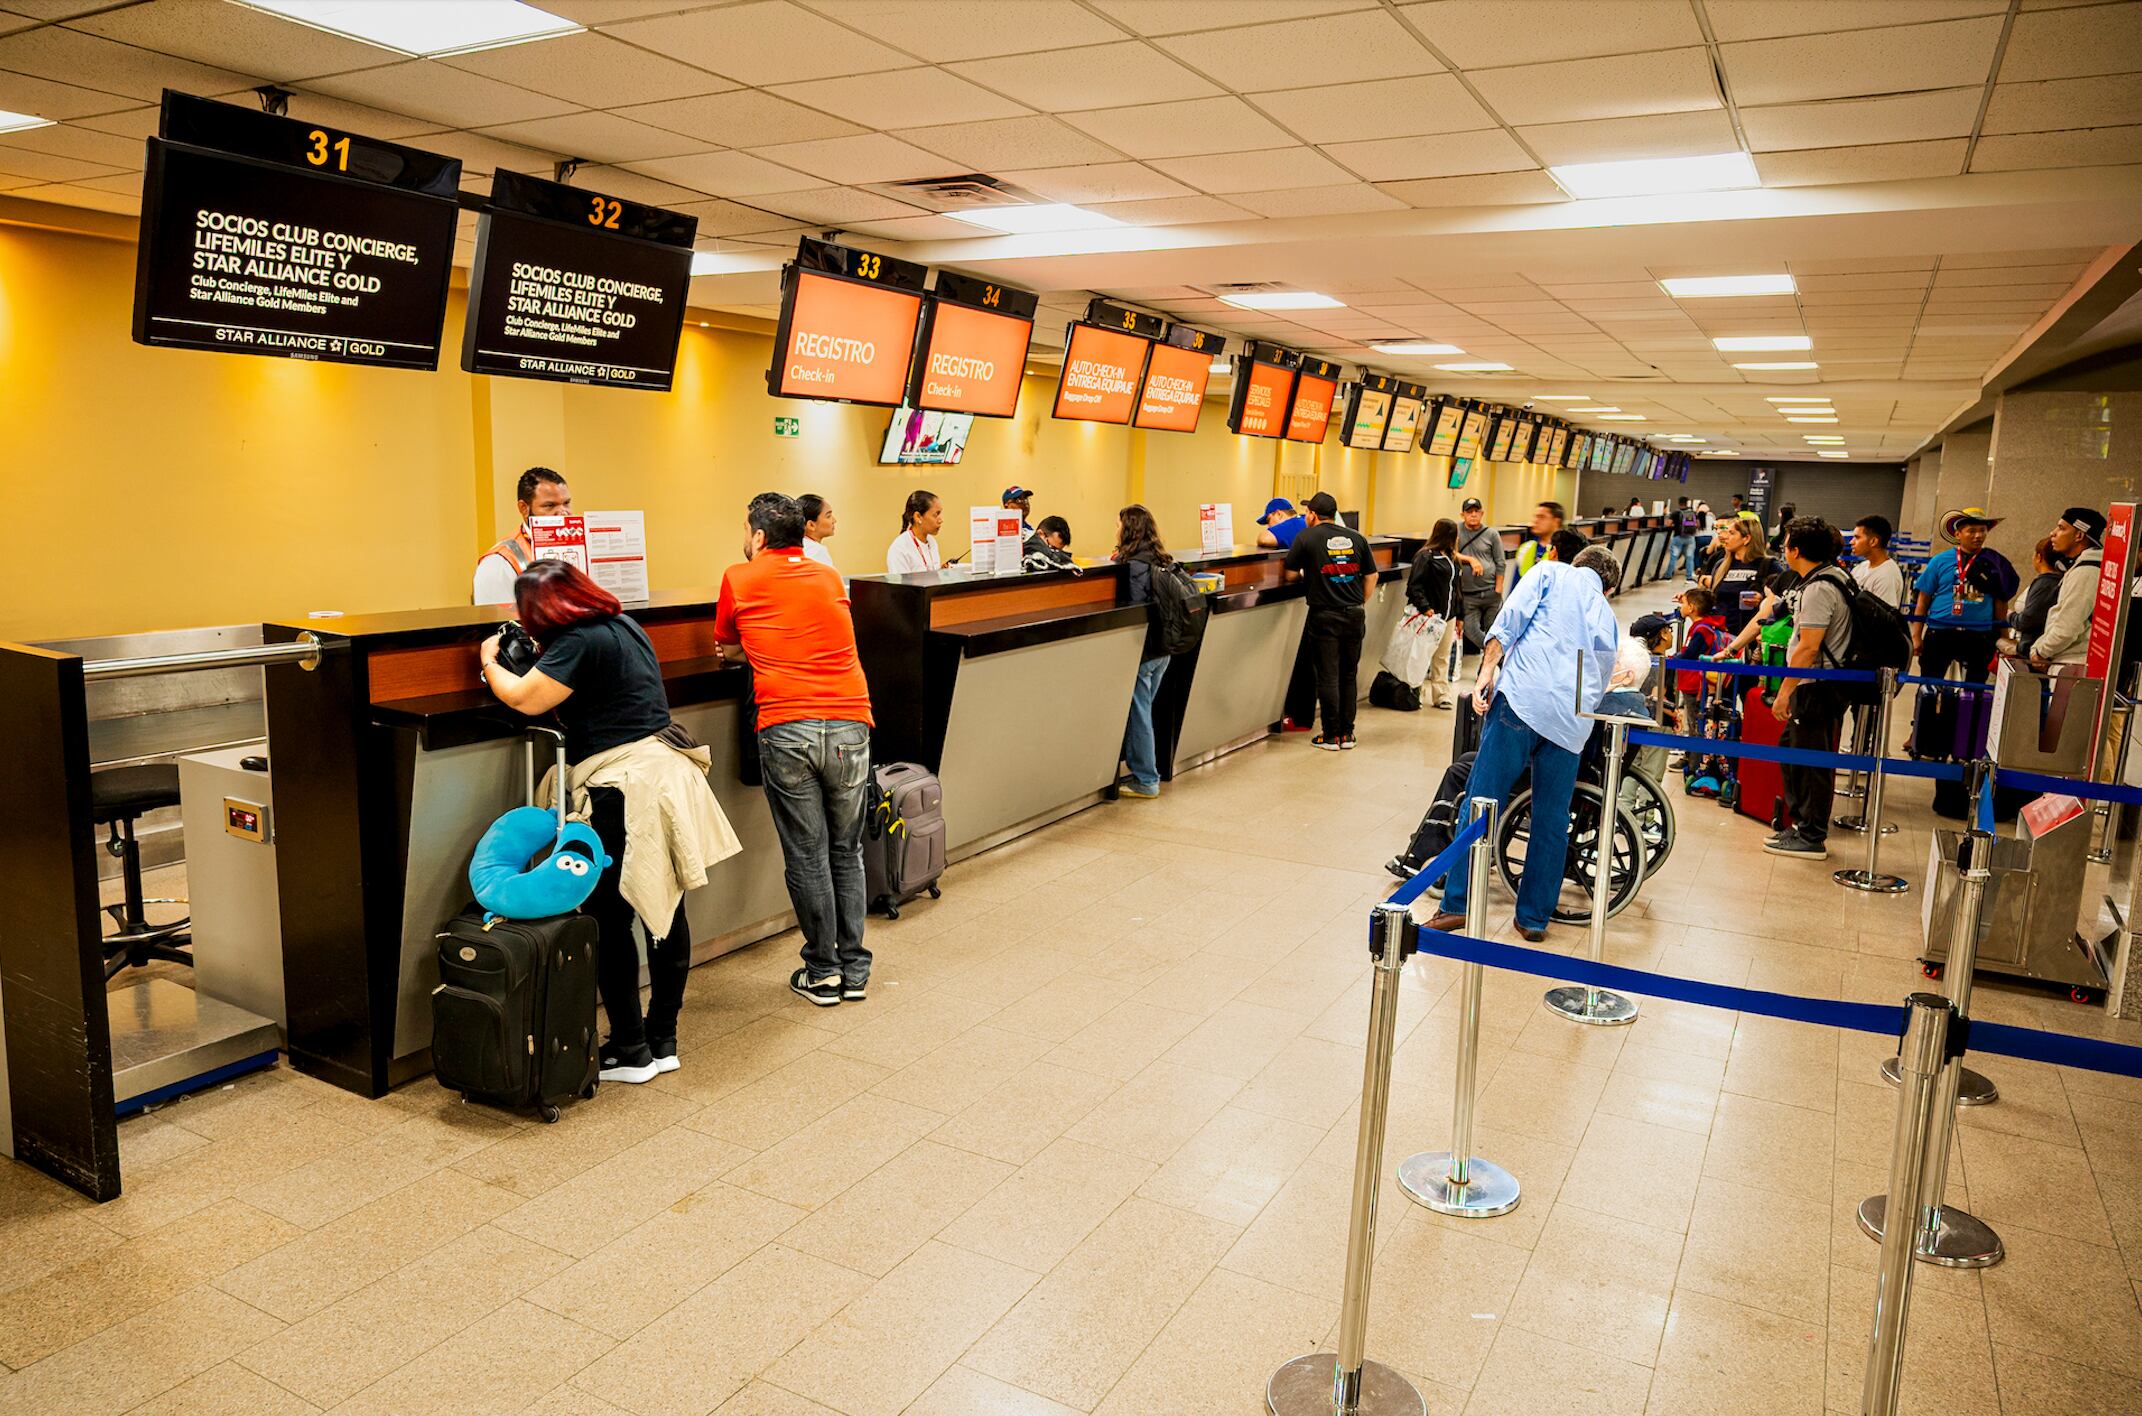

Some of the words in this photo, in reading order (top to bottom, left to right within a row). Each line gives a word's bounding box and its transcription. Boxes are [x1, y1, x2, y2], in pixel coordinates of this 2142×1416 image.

[306, 130, 350, 171] 31
[588, 197, 622, 230] 32
[194, 230, 287, 261] LIFEMILES
[290, 245, 336, 269] ELITE
[338, 253, 352, 271] Y
[196, 209, 270, 238] SOCIOS
[272, 223, 319, 246] CLUB
[322, 232, 420, 266] CONCIERGE,
[192, 252, 241, 275] STAR
[244, 259, 331, 286] ALLIANCE
[333, 272, 381, 293] GOLD
[856, 253, 881, 280] 33
[191, 275, 217, 289] Club
[218, 279, 273, 297] Concierge,
[273, 285, 318, 302] LifeMiles
[319, 292, 340, 304] Elite
[341, 296, 359, 307] and
[510, 278, 573, 303] LIFEMILES
[574, 289, 606, 309] ELITE
[607, 295, 617, 310] Y
[512, 262, 562, 285] SOCIOS
[563, 271, 595, 291] CLUB
[597, 277, 664, 305] CONCIERGE,
[982, 285, 1001, 307] 34
[189, 288, 213, 301] Star
[213, 291, 255, 306] Alliance
[256, 296, 281, 309] Gold
[281, 299, 327, 315] Members
[507, 296, 542, 314] STAR
[542, 302, 601, 324] ALLIANCE
[602, 312, 636, 329] GOLD
[505, 315, 524, 327] Club
[524, 317, 560, 333] Concierge,
[561, 322, 592, 336] LifeMiles
[592, 327, 607, 338] Elite
[607, 330, 620, 340] and
[1123, 311, 1136, 330] 35
[215, 328, 254, 344] STAR
[257, 333, 327, 351] ALLIANCE
[350, 341, 385, 357] GOLD
[504, 326, 520, 337] Star
[519, 328, 549, 341] Alliance
[549, 332, 566, 343] Gold
[566, 334, 598, 347] Members
[794, 331, 875, 365] REGISTRO
[1193, 332, 1204, 348] 36
[289, 351, 319, 360] SAMSUNG
[931, 353, 995, 381] REGISTRO
[519, 359, 546, 371] STAR
[547, 363, 595, 377] ALLIANCE
[611, 369, 636, 381] GOLD
[791, 364, 835, 384] Check-in
[1067, 372, 1100, 390] ENTREGA
[1099, 379, 1135, 395] EQUIPAJE
[1070, 360, 1092, 374] AUTO
[1092, 363, 1126, 380] CHECK-IN
[927, 382, 962, 398] Check-in
